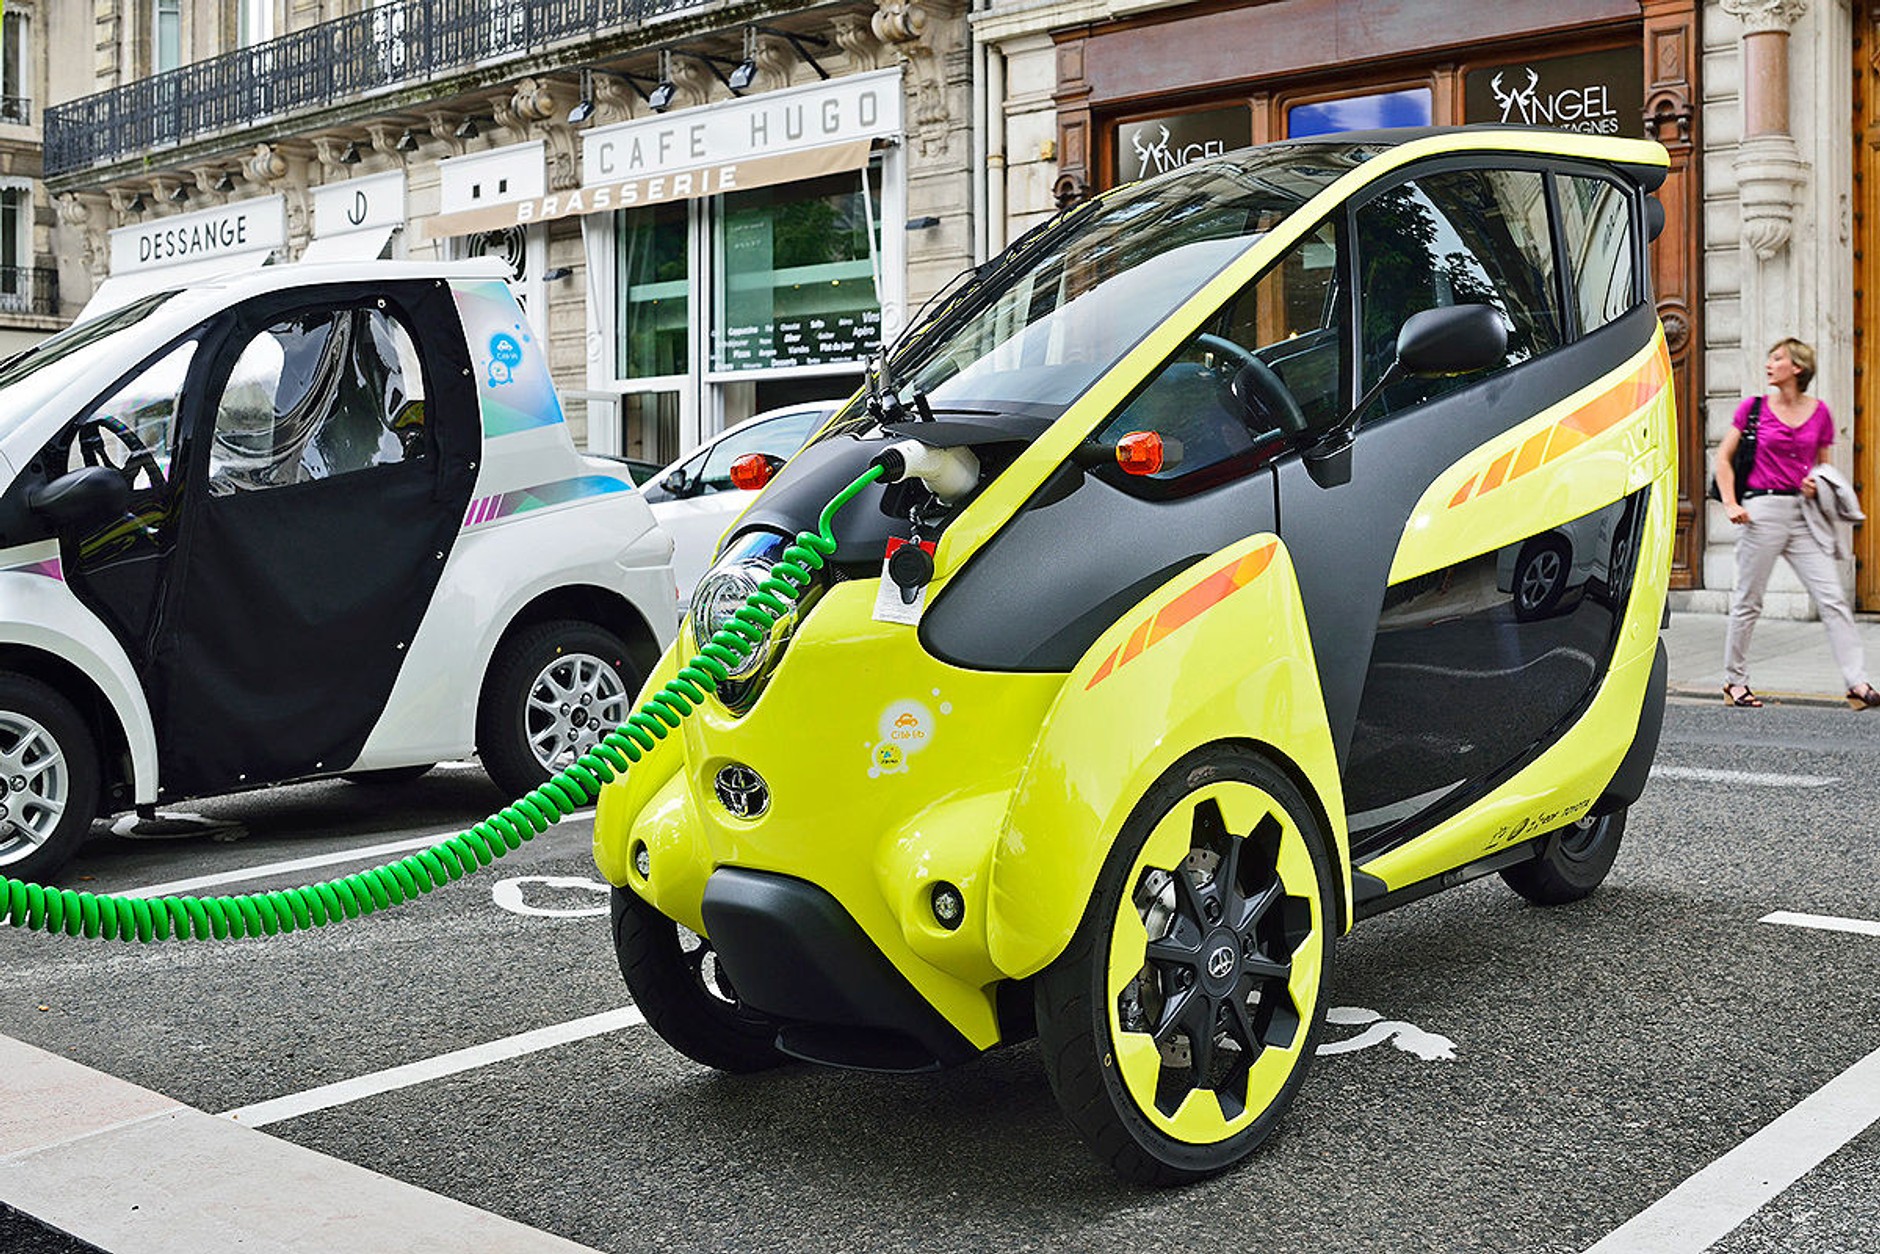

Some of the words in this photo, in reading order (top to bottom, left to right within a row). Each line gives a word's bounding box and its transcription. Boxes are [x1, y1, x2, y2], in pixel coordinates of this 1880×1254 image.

[1491, 67, 1617, 125] ANGEL
[600, 124, 706, 175] CAFE
[751, 91, 877, 148] HUGO
[517, 166, 738, 221] BRASSERIE
[140, 215, 246, 262] DESSANGE
